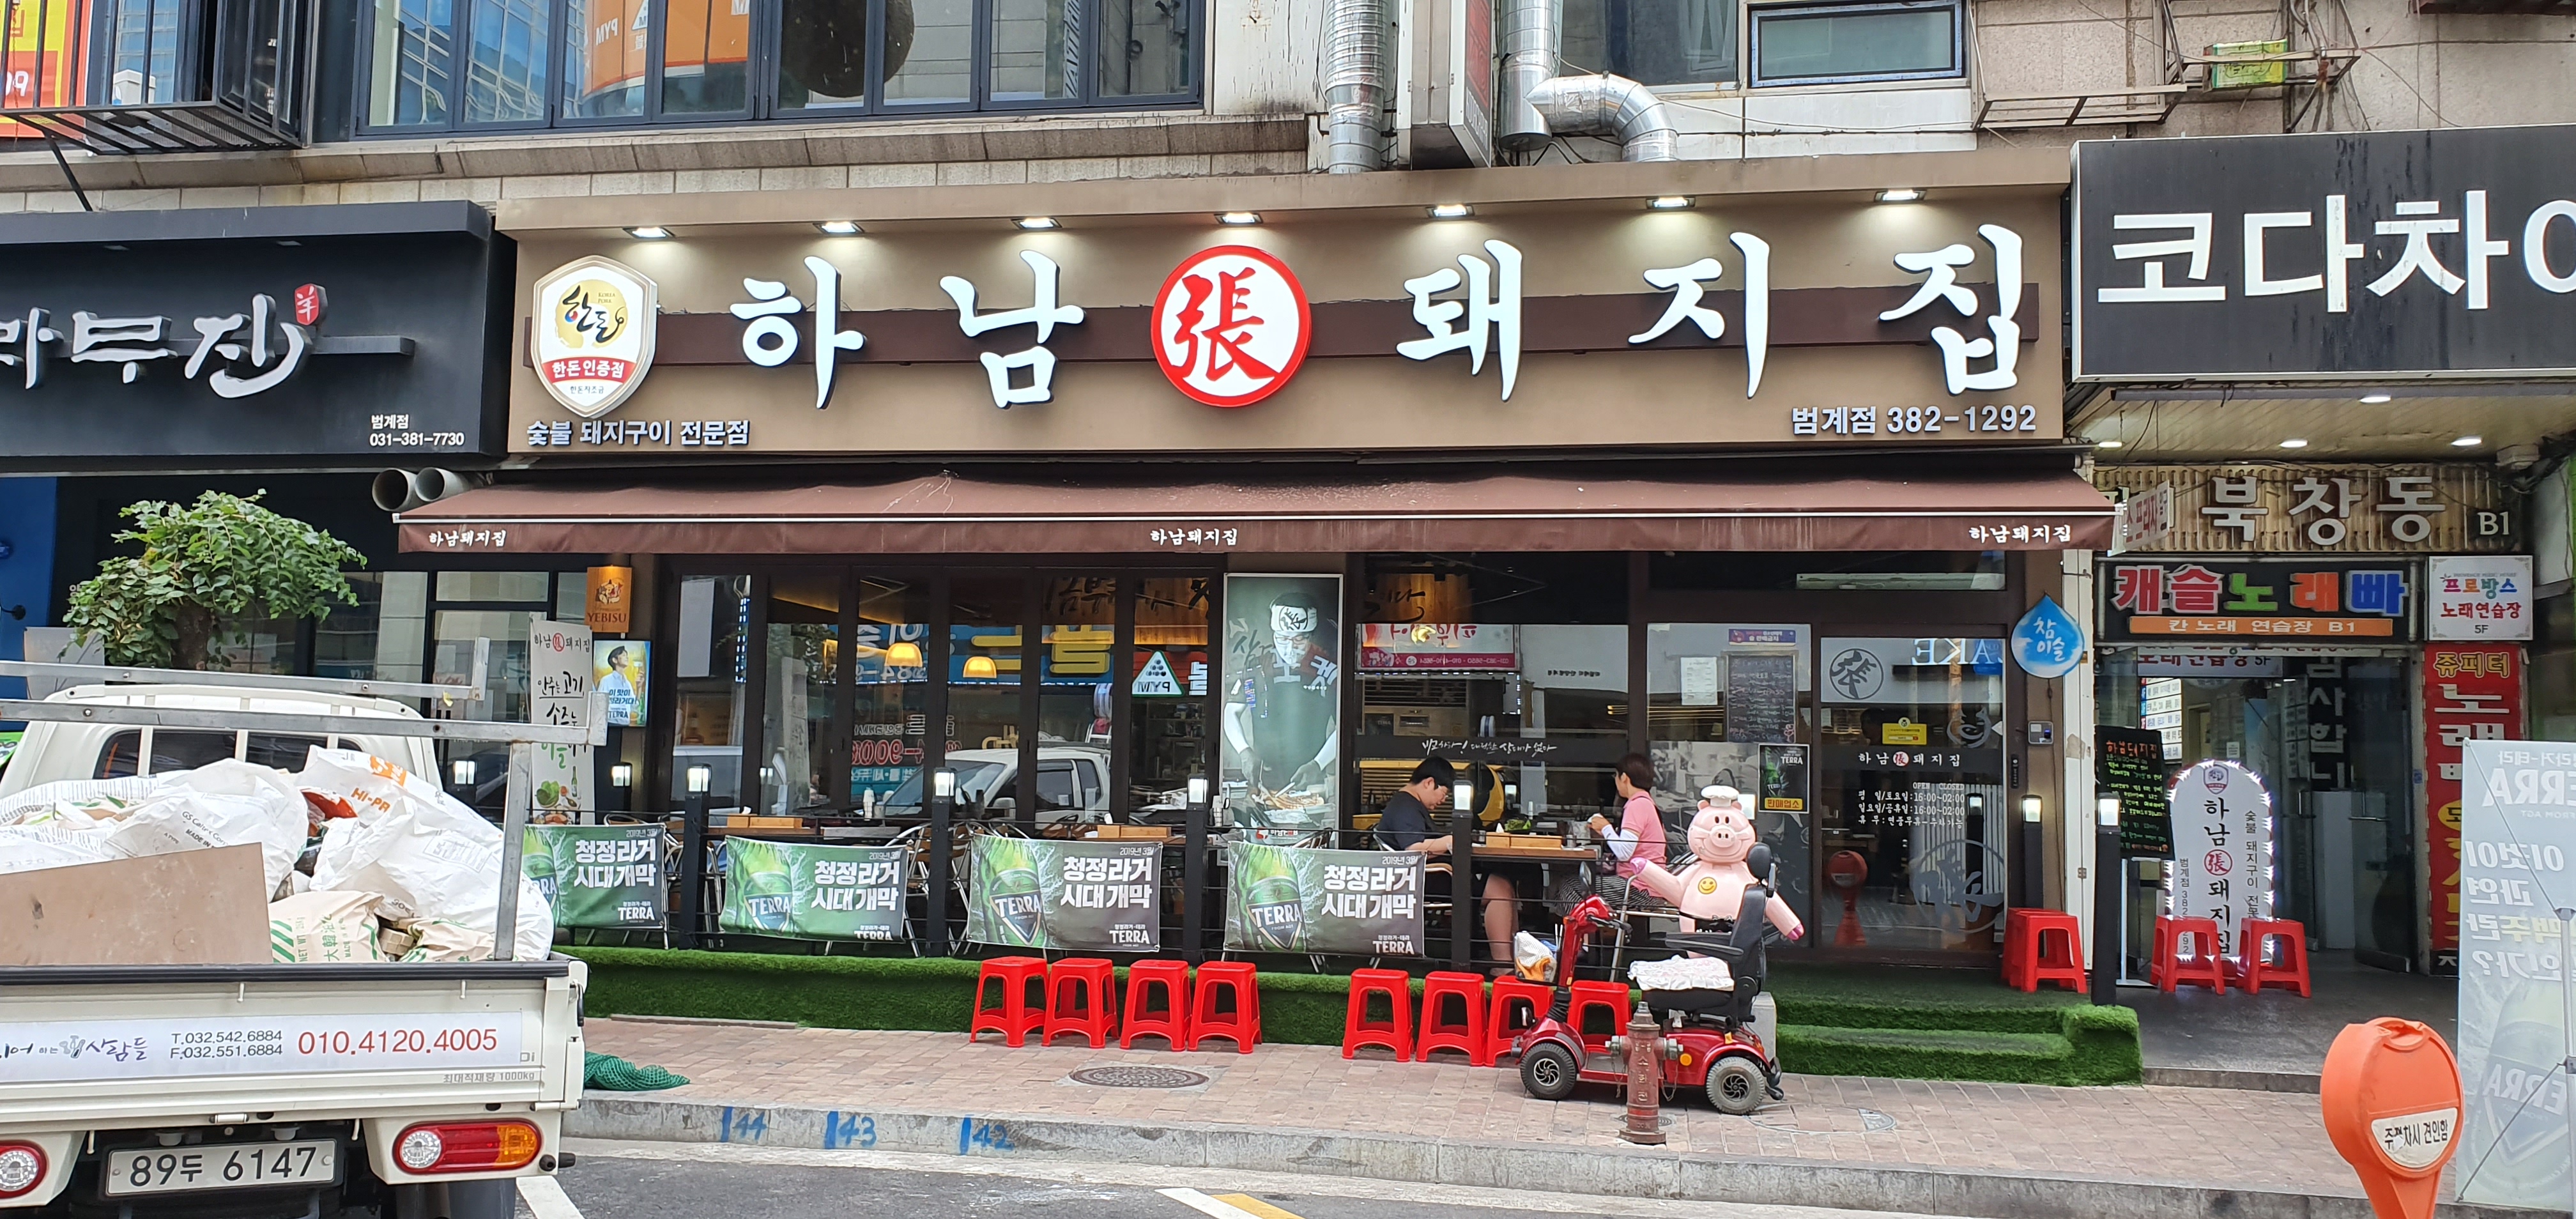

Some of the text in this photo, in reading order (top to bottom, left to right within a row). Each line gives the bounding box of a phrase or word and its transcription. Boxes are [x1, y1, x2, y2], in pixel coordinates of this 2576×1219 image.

[296, 287, 317, 324] 羊
[1167, 267, 1276, 382] 張
[371, 415, 409, 429] 범계점
[1792, 405, 2037, 434] 범계점 382-1292
[369, 432, 464, 447] 031-381-7730
[526, 420, 750, 446] 숯불 돼지구이 전문점
[2202, 476, 2446, 546] 북창동
[2478, 511, 2510, 536] B1
[429, 530, 507, 547] 하남돼지집
[1150, 528, 1238, 546] 하남돼지집
[1968, 525, 2071, 544] 하남돼지집
[2443, 578, 2518, 599] 프로방스
[587, 613, 627, 623] YEBISU
[2441, 602, 2522, 619] 노래연습장
[2169, 618, 2355, 633] 칸 노래 연습장 B1
[2474, 625, 2488, 633] 5F
[2037, 641, 2066, 662] 이슬
[2434, 652, 2510, 678] 쥬피터
[1781, 756, 1803, 765] TERRA
[1858, 752, 1889, 765] 하남
[1913, 752, 1961, 767] 돼지집
[1768, 799, 1799, 808] 판매업소
[183, 811, 193, 820] GS
[2204, 797, 2230, 847] 하남
[186, 829, 203, 843] MADE
[626, 829, 646, 838] 2019년
[869, 852, 889, 860] 2019년
[1120, 847, 1141, 856] 2019년
[1382, 856, 1404, 865] 2019년
[2207, 852, 2228, 873] 張
[2244, 810, 2259, 918] 숯불 돼지구이 전문
[2179, 858, 2189, 888] 범계점
[535, 878, 557, 894] RRA
[618, 907, 654, 921] TERRA
[748, 895, 792, 916] TERRA
[995, 894, 1041, 918] TERRA
[1251, 903, 1302, 927] TERRA
[854, 930, 893, 941] TERRA
[1109, 930, 1150, 944] TERRA
[1372, 940, 1414, 955] TERRA
[171, 1030, 282, 1045] T.032.542.6884
[298, 1029, 497, 1055] 010.4120.4005
[86, 1038, 148, 1062] 사람들
[170, 1045, 282, 1059] F.032.551.6884
[443, 1071, 535, 1084] 최대적재량 1000kg
[734, 1112, 766, 1140] 44
[838, 1115, 877, 1147] 43
[2423, 1119, 2448, 1144] 견인함
[972, 1123, 1013, 1149] 42
[130, 1147, 317, 1186] 89두 6147
